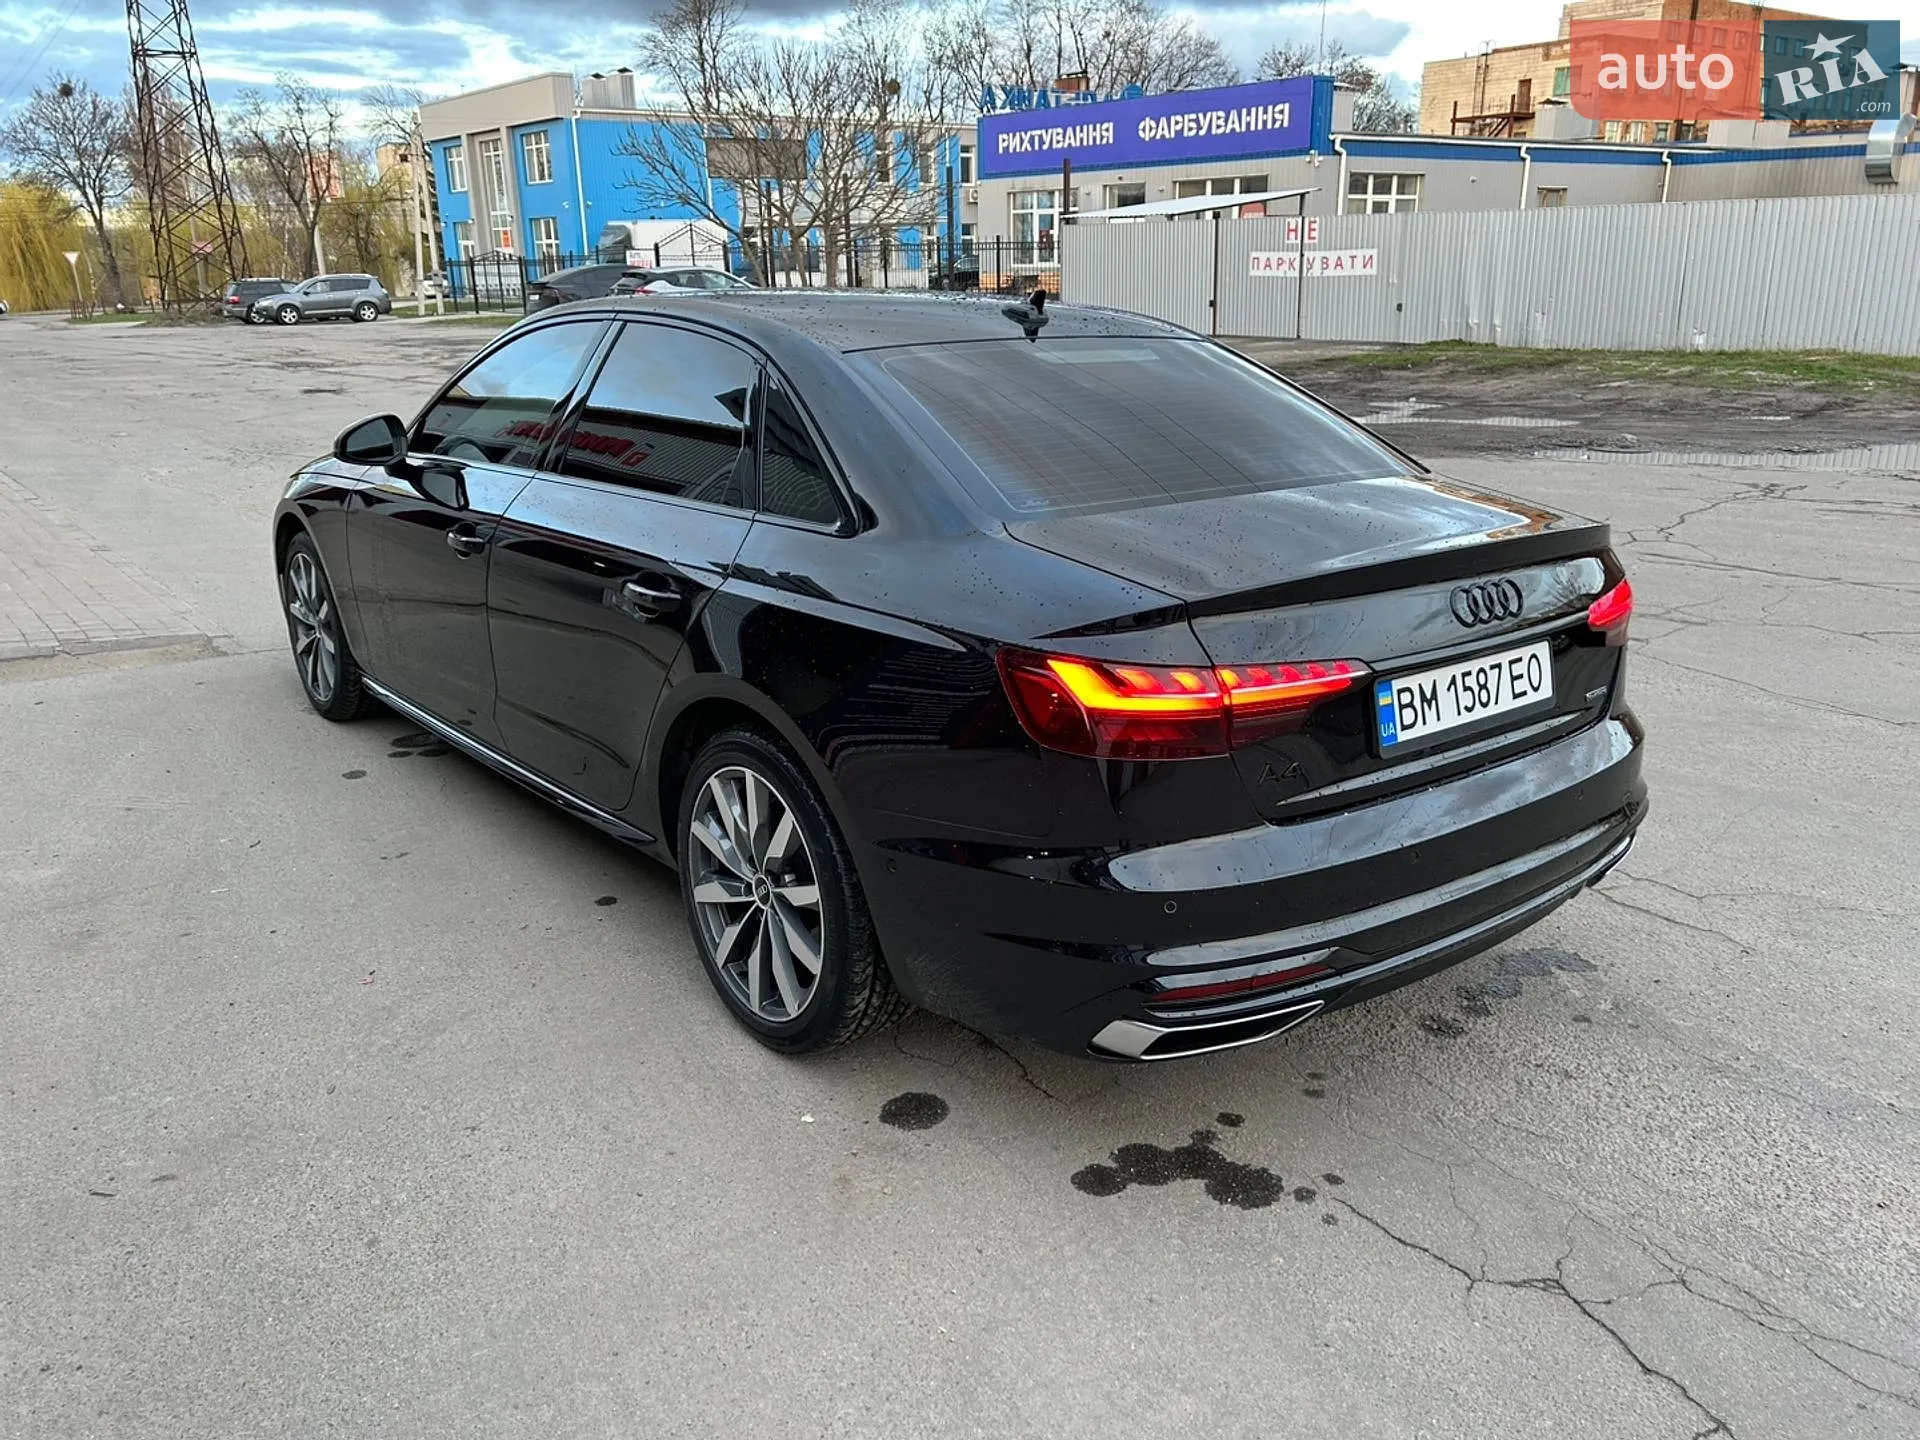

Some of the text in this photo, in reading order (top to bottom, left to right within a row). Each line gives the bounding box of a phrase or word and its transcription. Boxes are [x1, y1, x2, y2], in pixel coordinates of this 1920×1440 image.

[998, 102, 1290, 154] РИХТУВАННЯ ФАРБУВАННЯ
[1286, 219, 1318, 241] НЕ
[1251, 254, 1374, 271] ПАРКУВАТИ
[1396, 678, 1441, 732] BM
[1446, 661, 1503, 717] 1587
[1381, 723, 1396, 737] UA
[1257, 760, 1304, 787] A4
